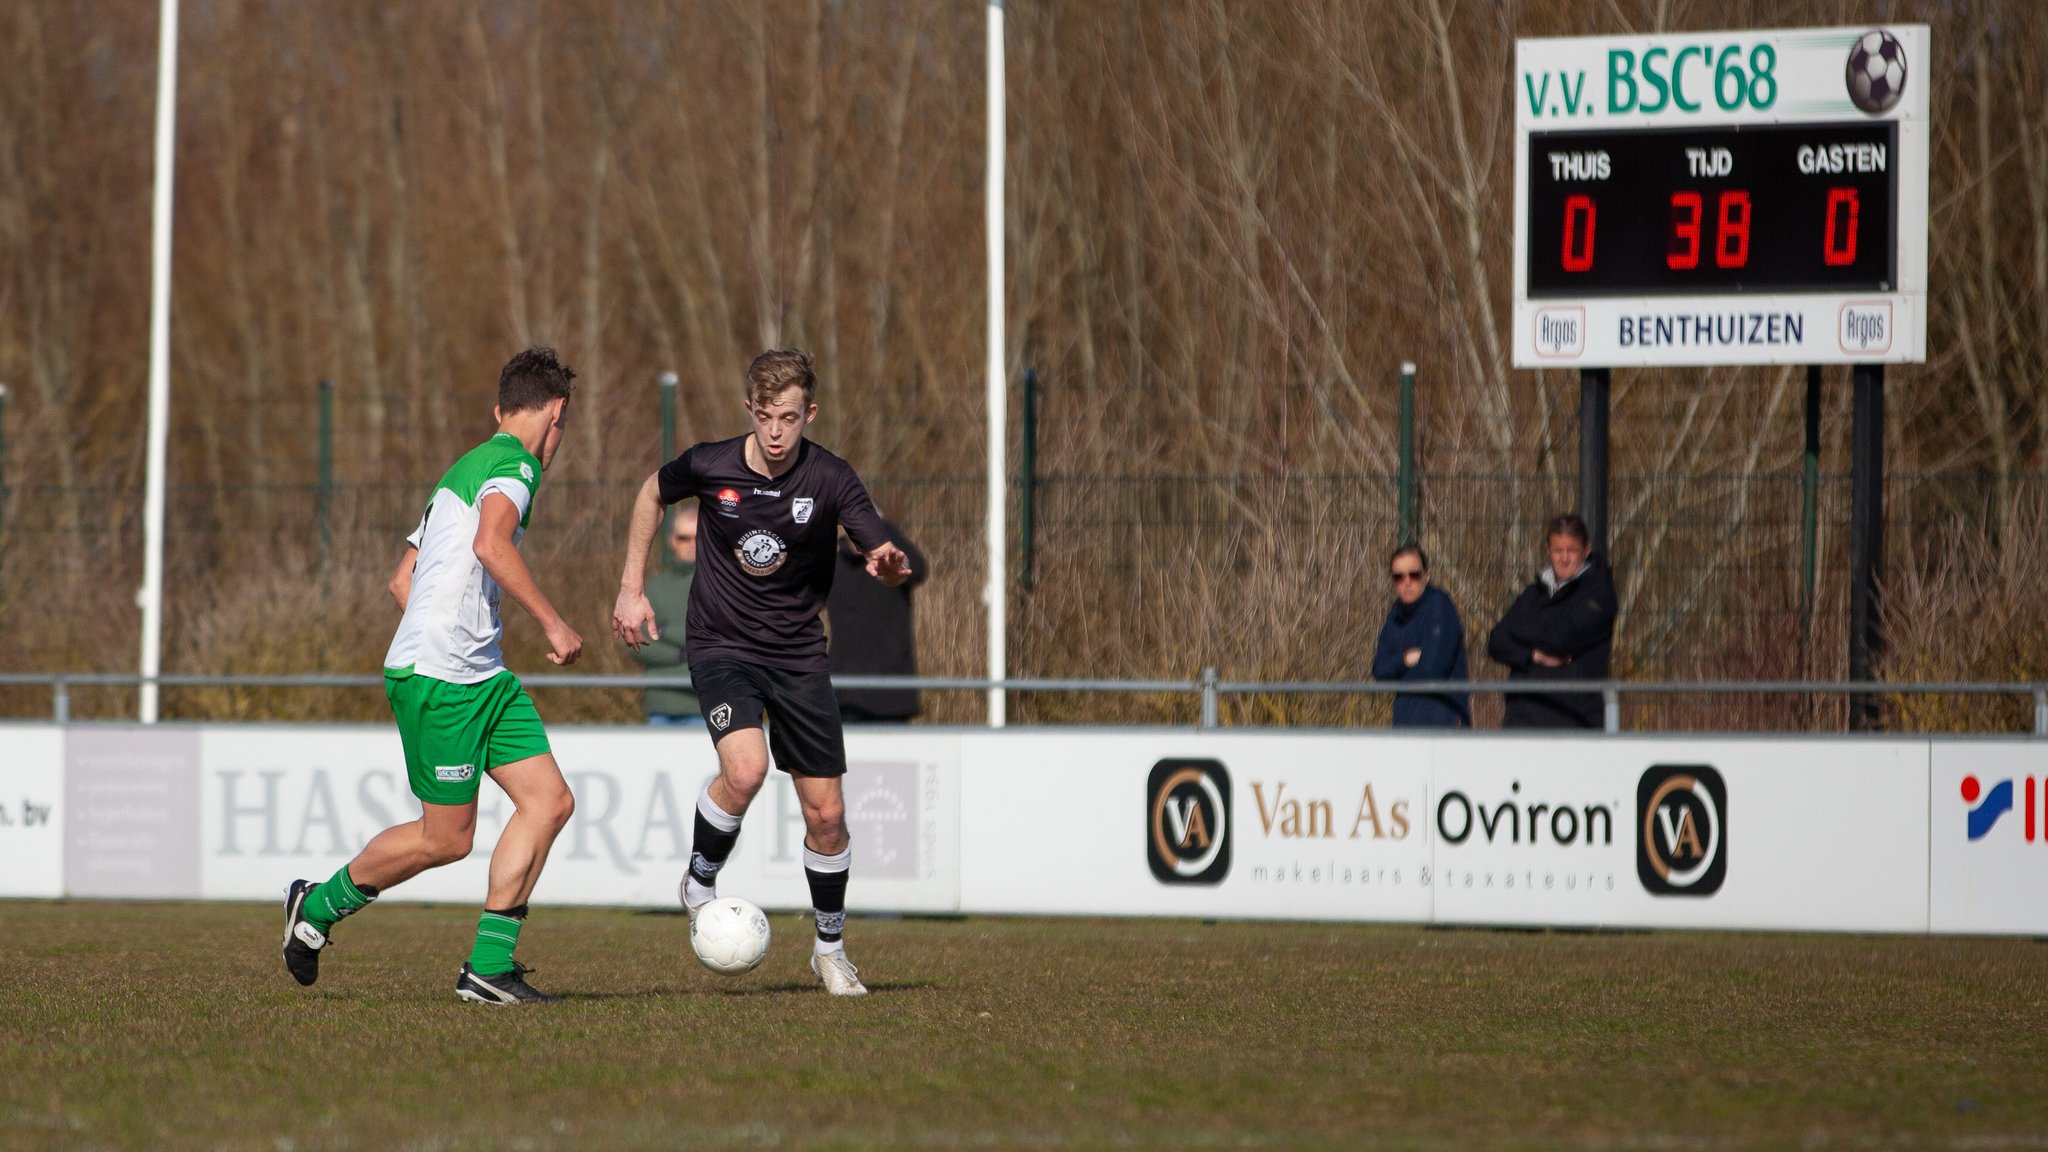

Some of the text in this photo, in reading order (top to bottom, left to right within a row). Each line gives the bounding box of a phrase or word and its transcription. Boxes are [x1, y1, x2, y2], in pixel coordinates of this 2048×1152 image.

[1607, 43, 1778, 116] BSC'68
[1548, 150, 1611, 180] THUIS
[1686, 147, 1733, 177] TIJD
[1798, 143, 1887, 174] GASTEN
[1561, 194, 1597, 272] 0
[1667, 190, 1752, 270] 38
[1824, 187, 1860, 267] 0
[1541, 315, 1578, 352] Argos
[1619, 314, 1805, 347] BENTHUIZEN
[1847, 311, 1885, 349] Argos
[1250, 780, 1614, 846] Van As Oviron
[1254, 860, 1615, 890] makelaars & taxateurs
